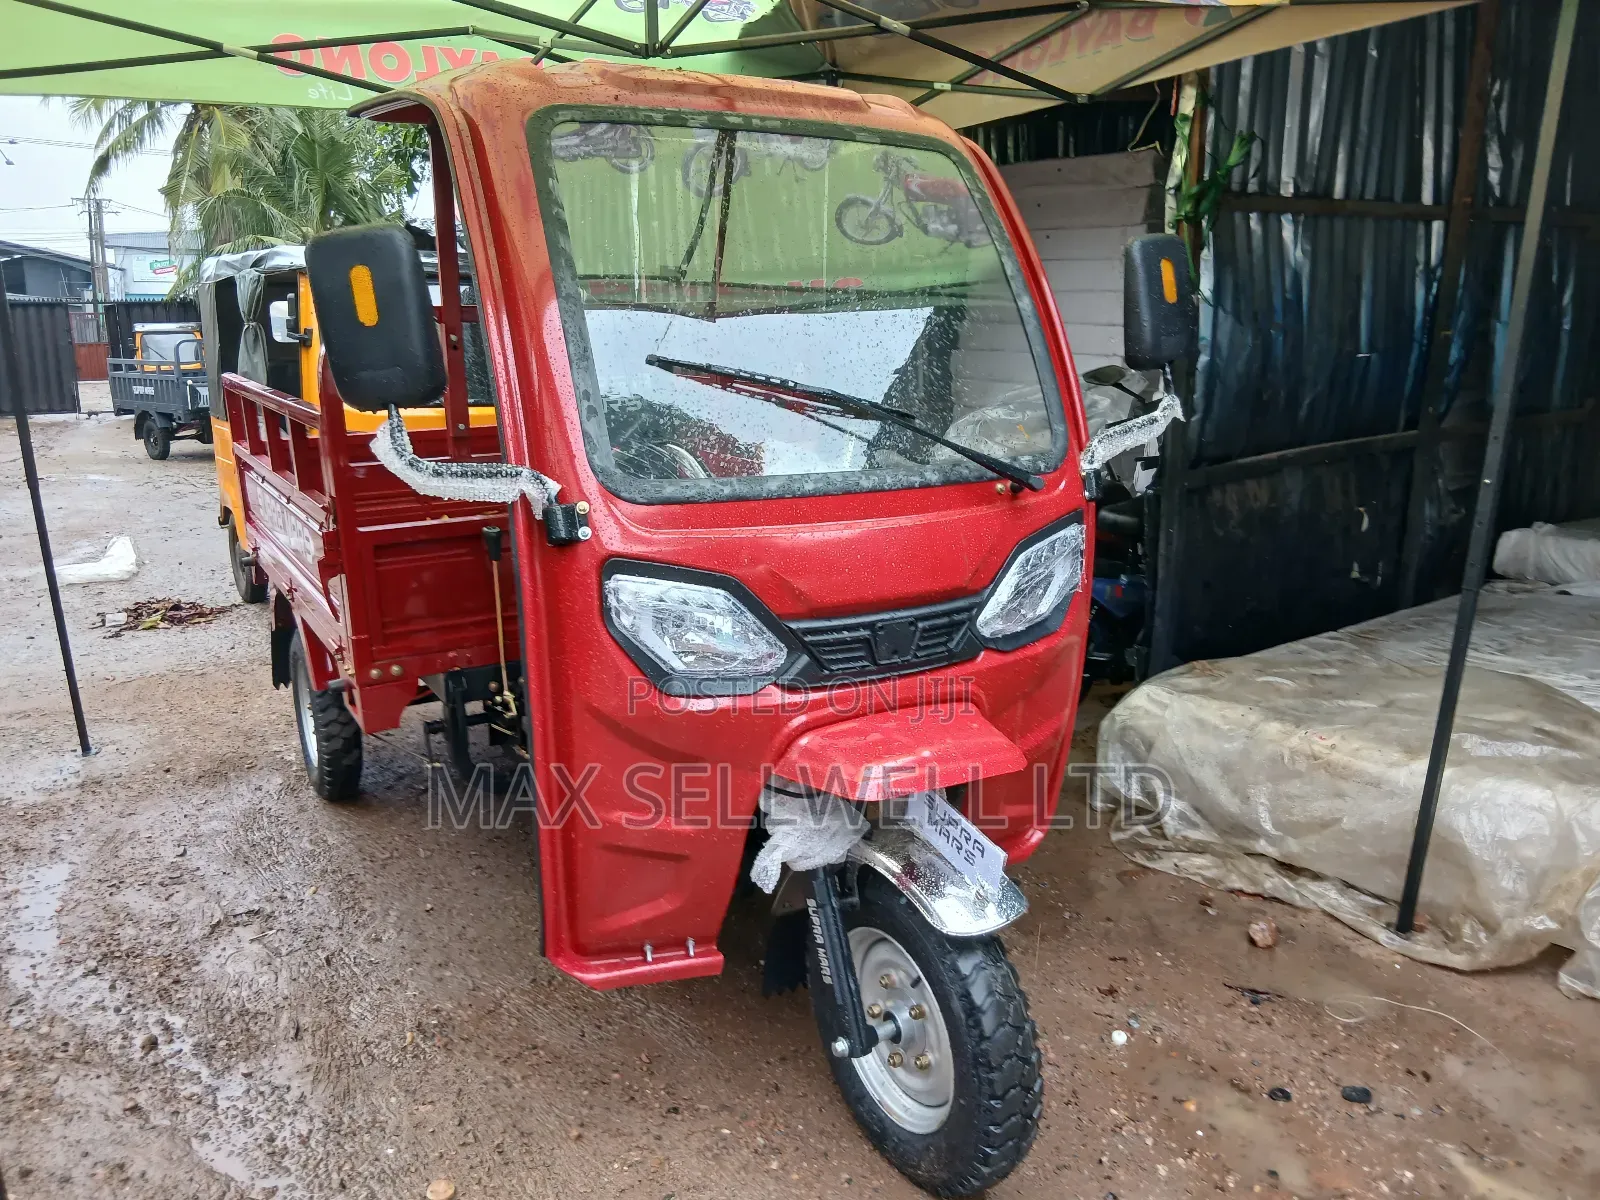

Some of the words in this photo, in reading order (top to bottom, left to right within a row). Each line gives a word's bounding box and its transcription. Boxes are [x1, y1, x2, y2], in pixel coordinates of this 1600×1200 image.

[923, 792, 985, 859] SUPRA
[926, 809, 977, 867] MARS
[805, 898, 825, 944] SUPRA
[816, 947, 833, 985] MARS
